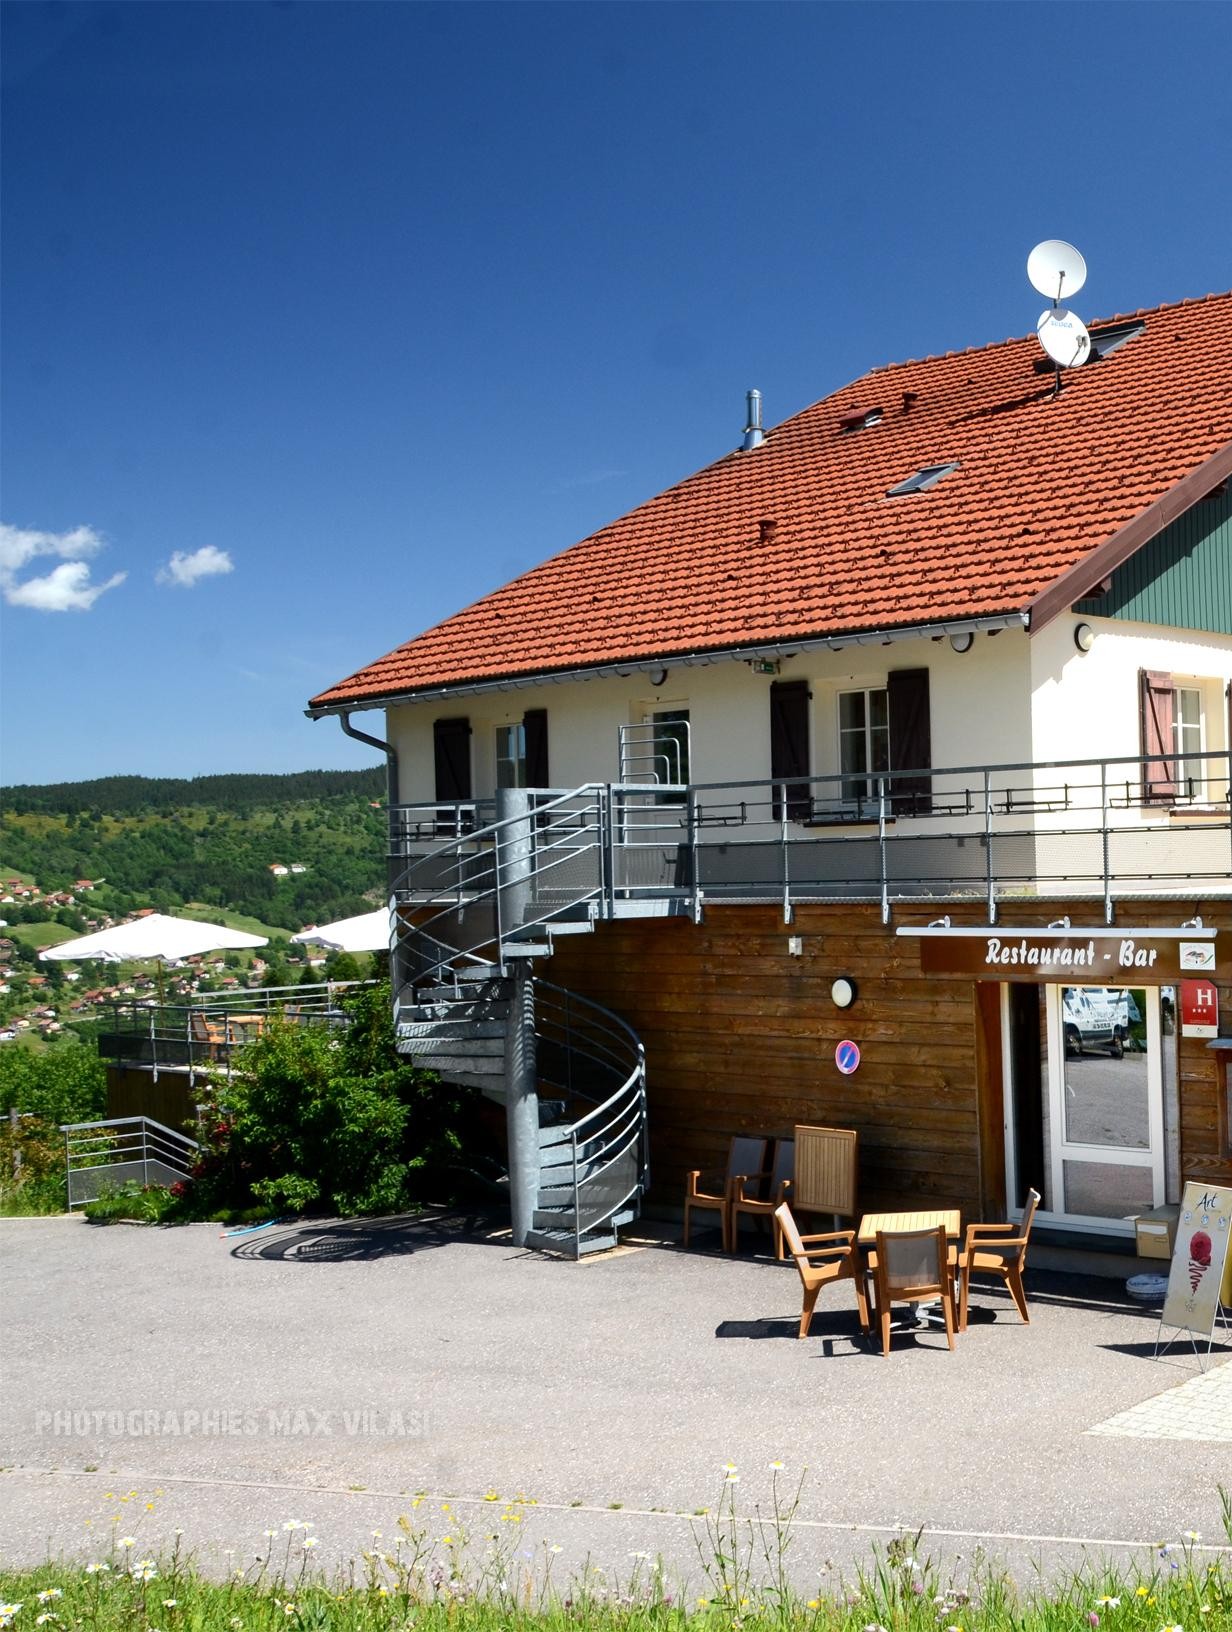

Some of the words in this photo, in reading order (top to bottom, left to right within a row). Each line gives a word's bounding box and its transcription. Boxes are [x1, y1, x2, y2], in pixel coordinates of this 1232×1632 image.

[985, 938, 1096, 967] Restaurant
[1118, 939, 1158, 967] Bar
[1196, 988, 1214, 1006] H
